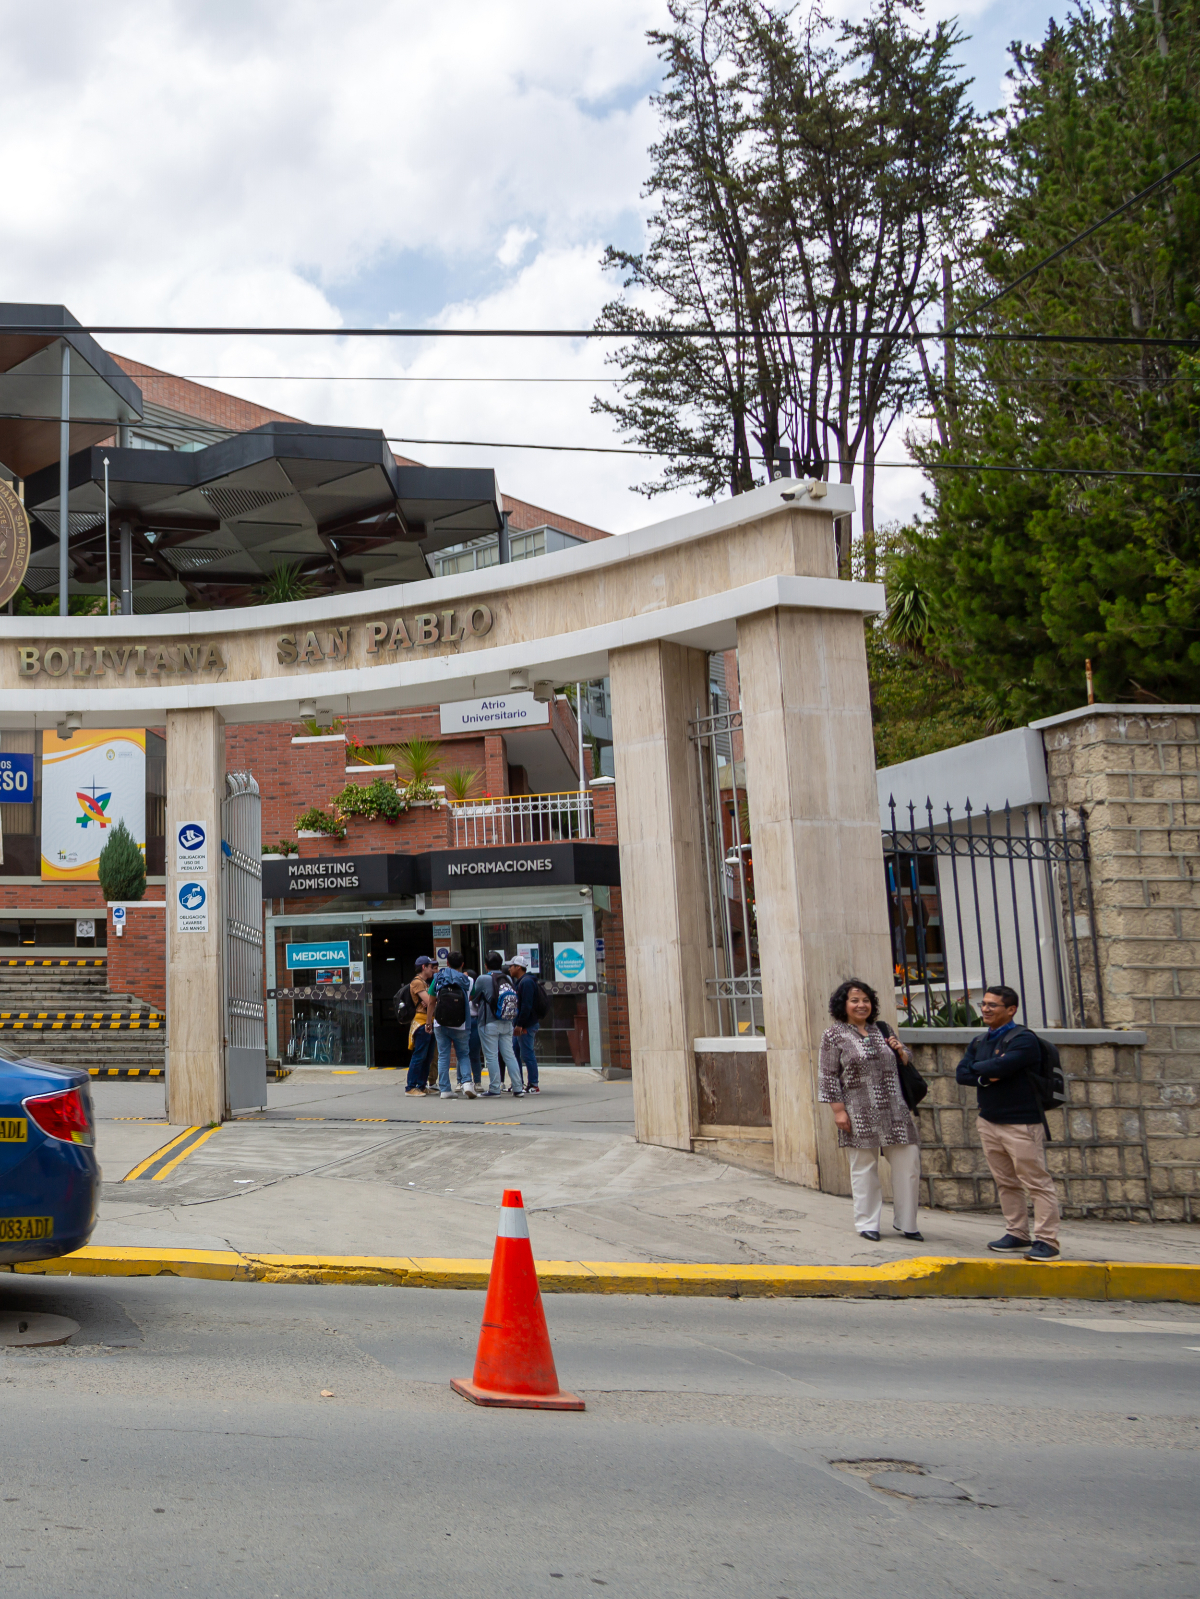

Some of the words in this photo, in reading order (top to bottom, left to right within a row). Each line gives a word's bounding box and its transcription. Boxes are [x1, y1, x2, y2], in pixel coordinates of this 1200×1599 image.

[18, 641, 227, 676] BOLIVIANA
[276, 626, 350, 664] SAN
[366, 604, 493, 653] PABLO
[481, 700, 506, 710] Atrio
[462, 709, 527, 724] Universitario
[288, 862, 355, 876] MARKETING
[448, 859, 552, 876] INFORMACIONES
[289, 876, 359, 890] ADMISIONES
[292, 950, 346, 961] MEDICINA
